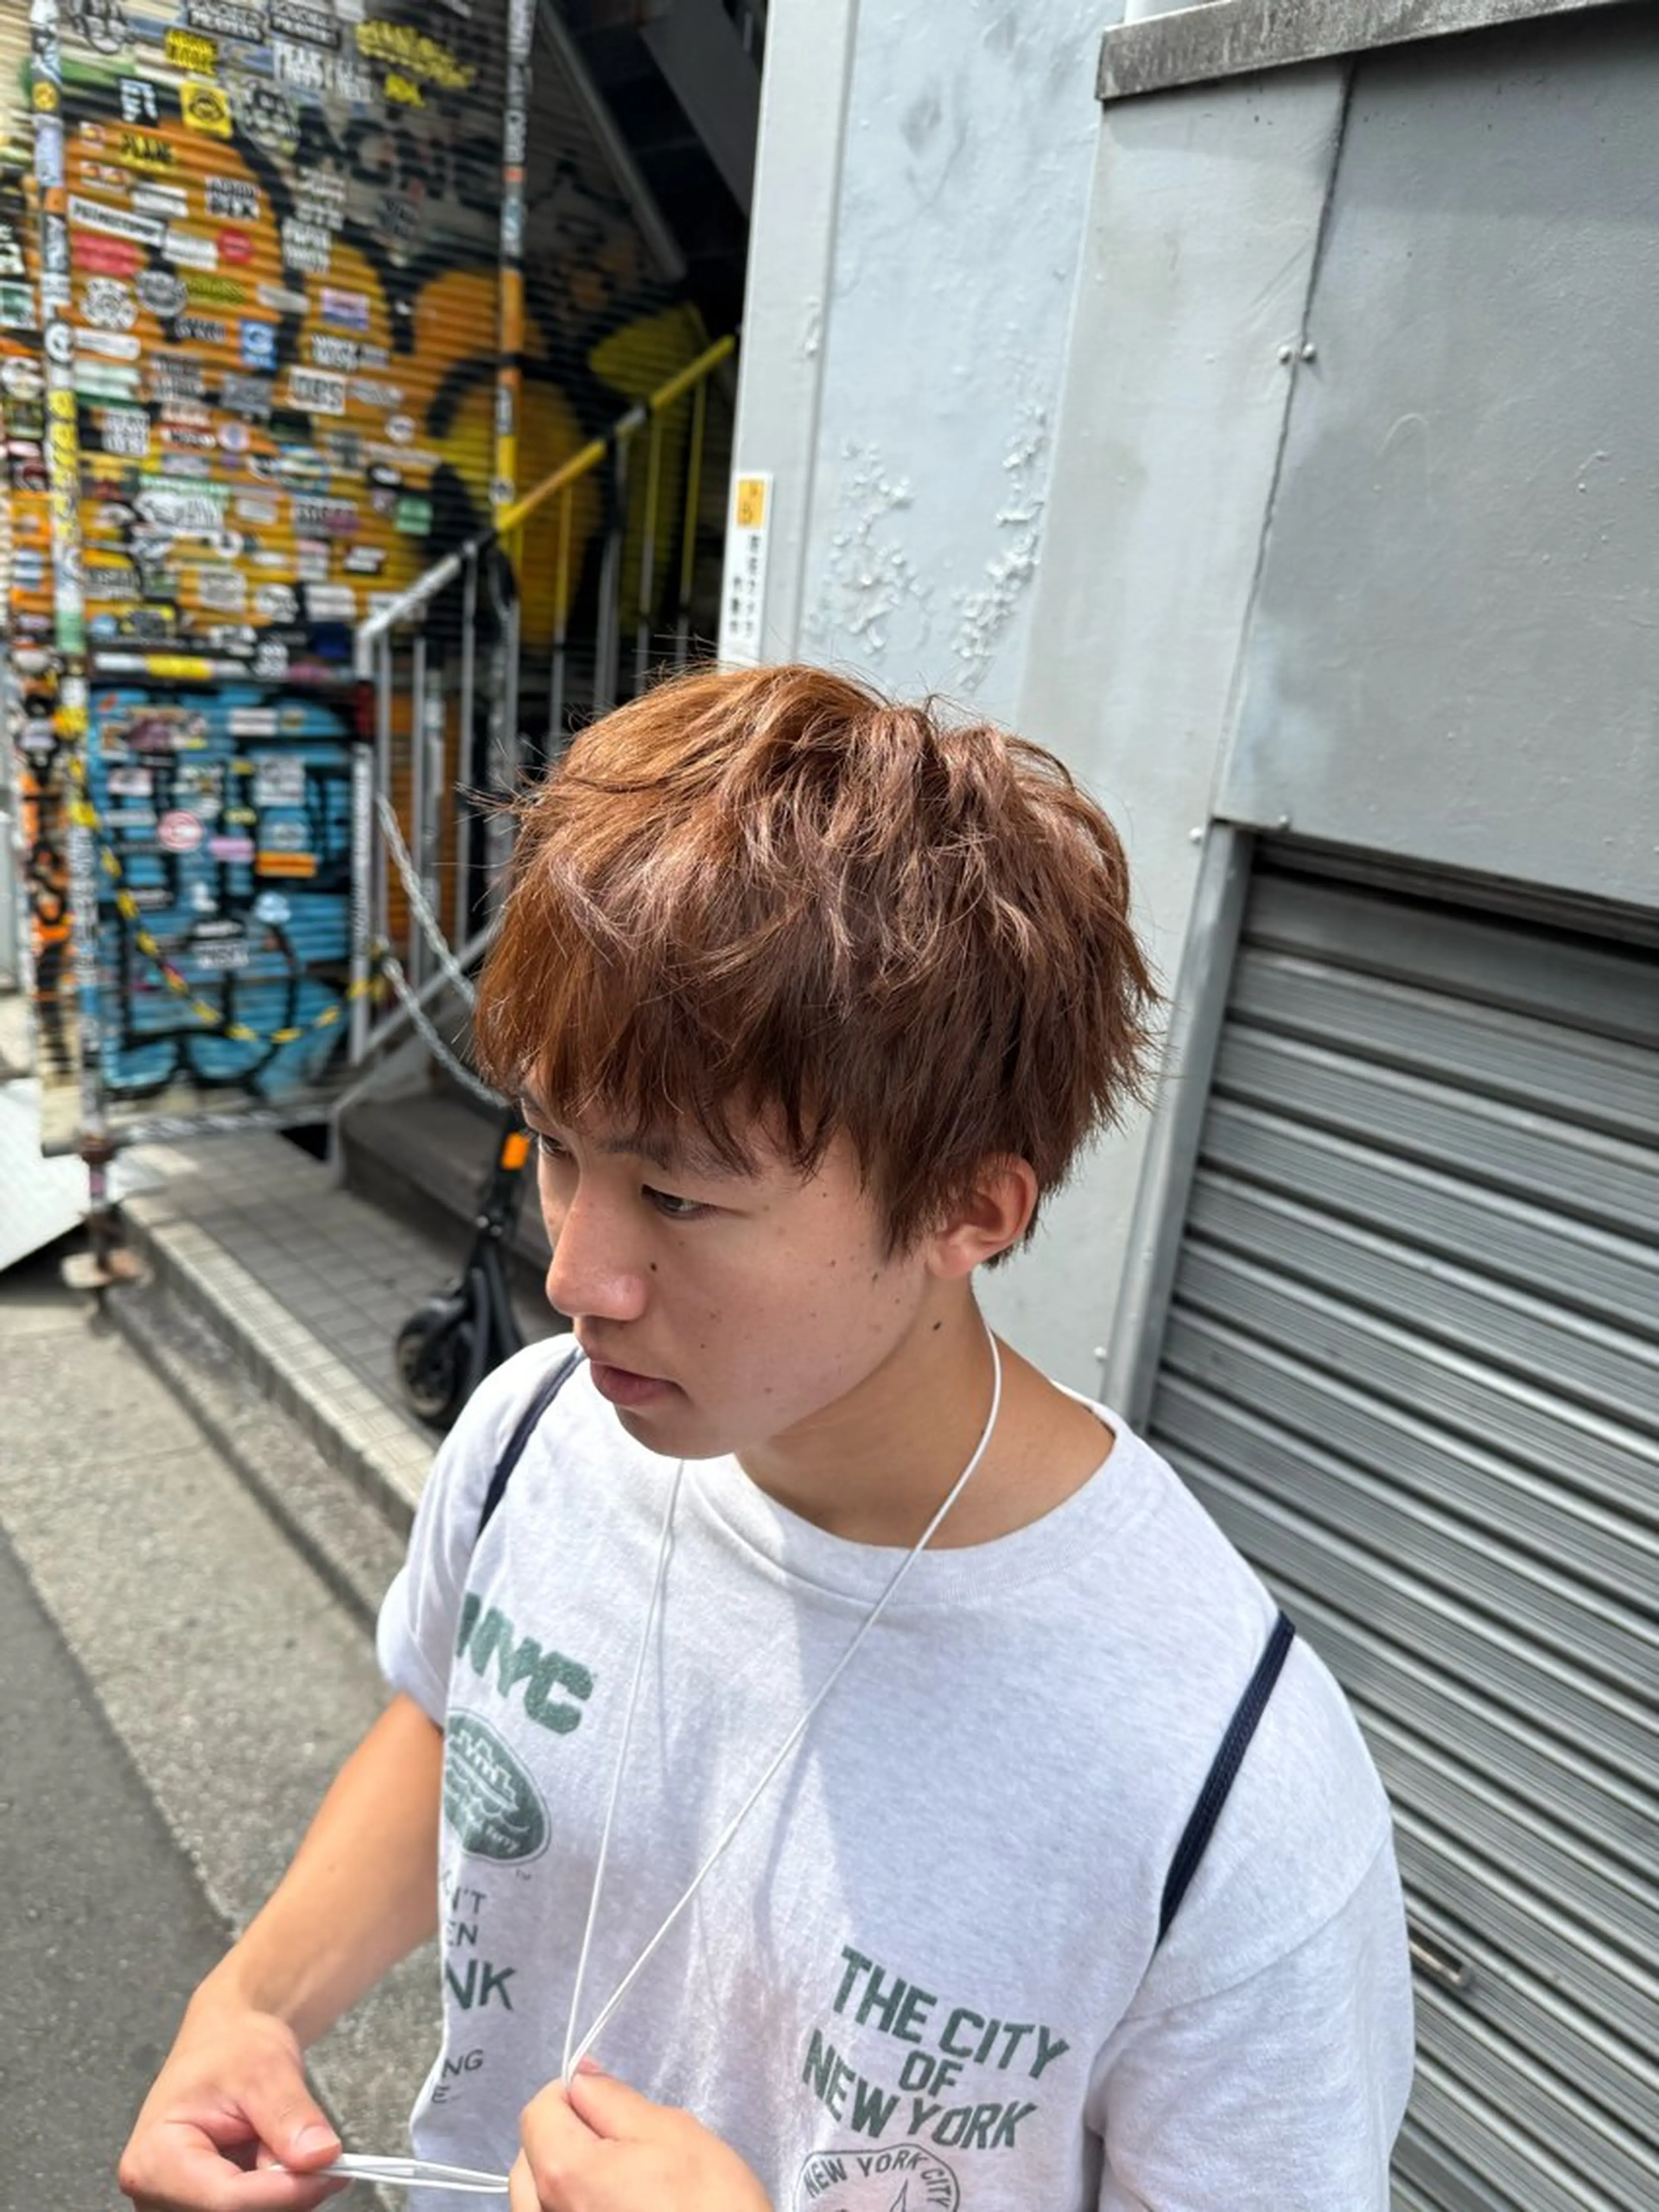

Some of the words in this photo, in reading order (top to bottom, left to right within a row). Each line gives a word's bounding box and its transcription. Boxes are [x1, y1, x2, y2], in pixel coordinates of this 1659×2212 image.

[833, 1944, 938, 2044] THE
[938, 2007, 1070, 2080] CITY
[802, 2028, 901, 2138] NEW
[907, 2097, 1039, 2149] YORK
[899, 2050, 963, 2097] OF
[803, 2158, 848, 2198] NEW
[857, 2150, 929, 2178] YORK
[920, 2168, 952, 2209] CITY
